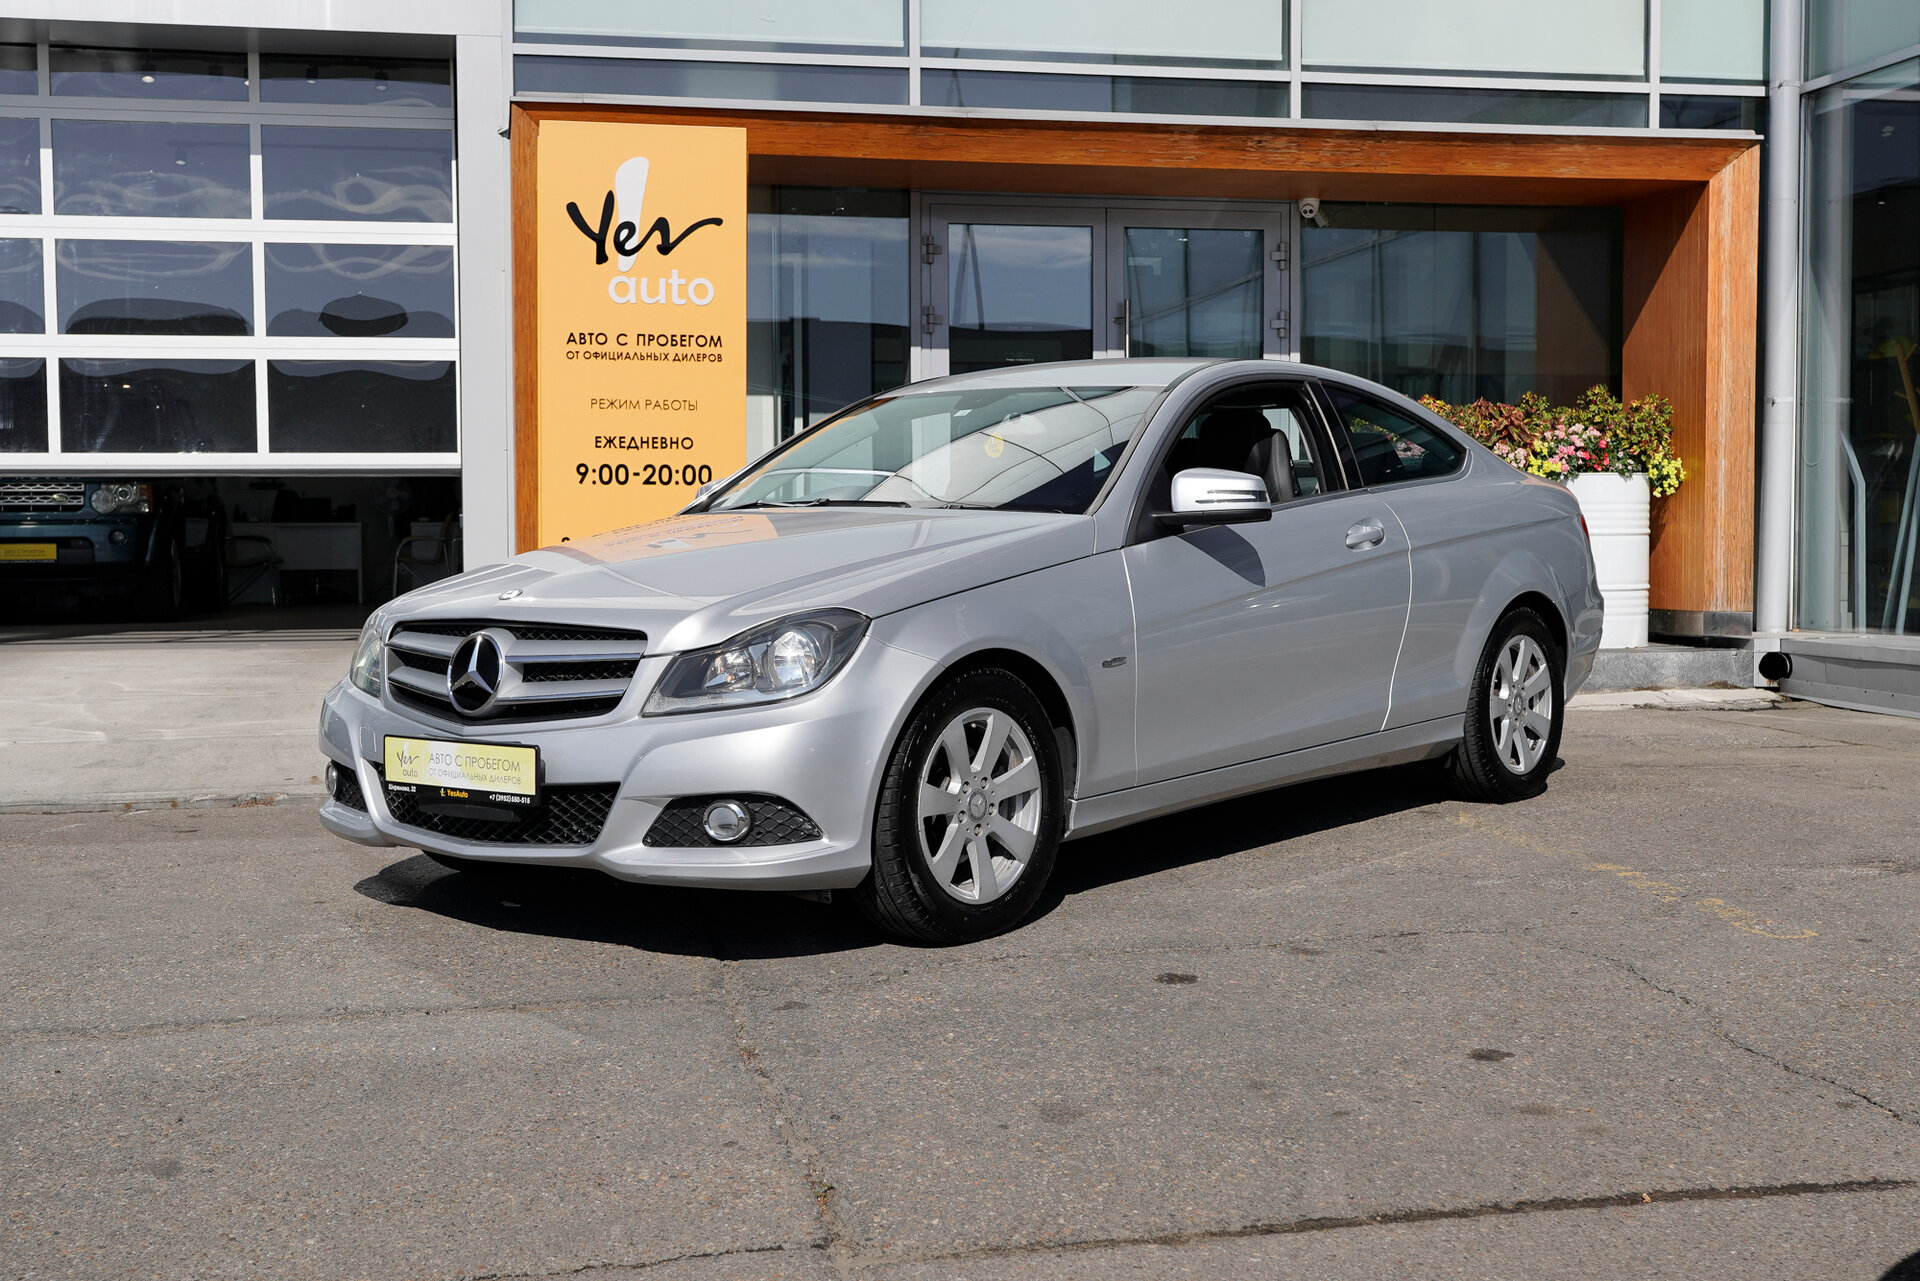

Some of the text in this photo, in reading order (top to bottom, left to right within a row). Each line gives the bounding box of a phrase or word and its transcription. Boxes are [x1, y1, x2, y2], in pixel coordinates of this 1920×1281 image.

[608, 269, 715, 305] auto
[566, 332, 723, 348] АВТО С ПРОБЕГОМ
[566, 351, 723, 362] ОТ ОФИЦИАЛЬНЫХ ДИЛЕРОВ
[590, 398, 698, 411] РЕЖИМ РАБОТЫ
[594, 435, 694, 450] ЕЖЕДНЕВНО
[576, 463, 712, 486] 9:00-20:00
[429, 753, 520, 772] АВТО С ПРОБЕГОМ
[403, 769, 418, 777] auto
[429, 768, 522, 785] ОТ ОФИЦИАЛЬНЫХ ДИЛЕРОВ
[446, 789, 469, 799] YesAuto
